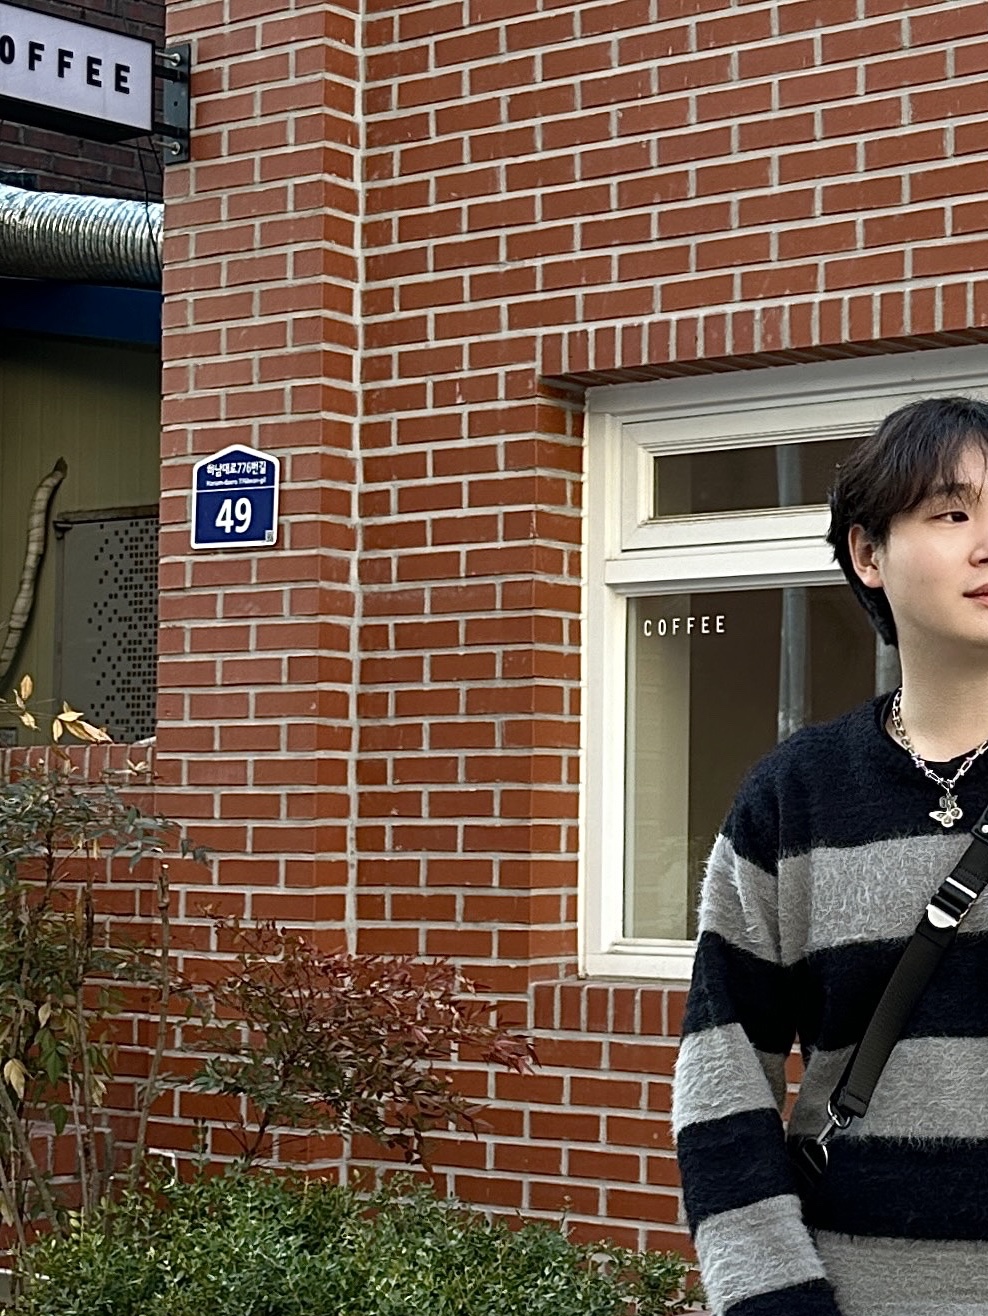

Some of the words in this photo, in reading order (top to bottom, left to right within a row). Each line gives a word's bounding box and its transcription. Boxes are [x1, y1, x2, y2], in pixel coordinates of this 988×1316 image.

[0, 35, 130, 94] OFFEE
[215, 498, 252, 533] 49
[644, 615, 725, 637] COFFEE
